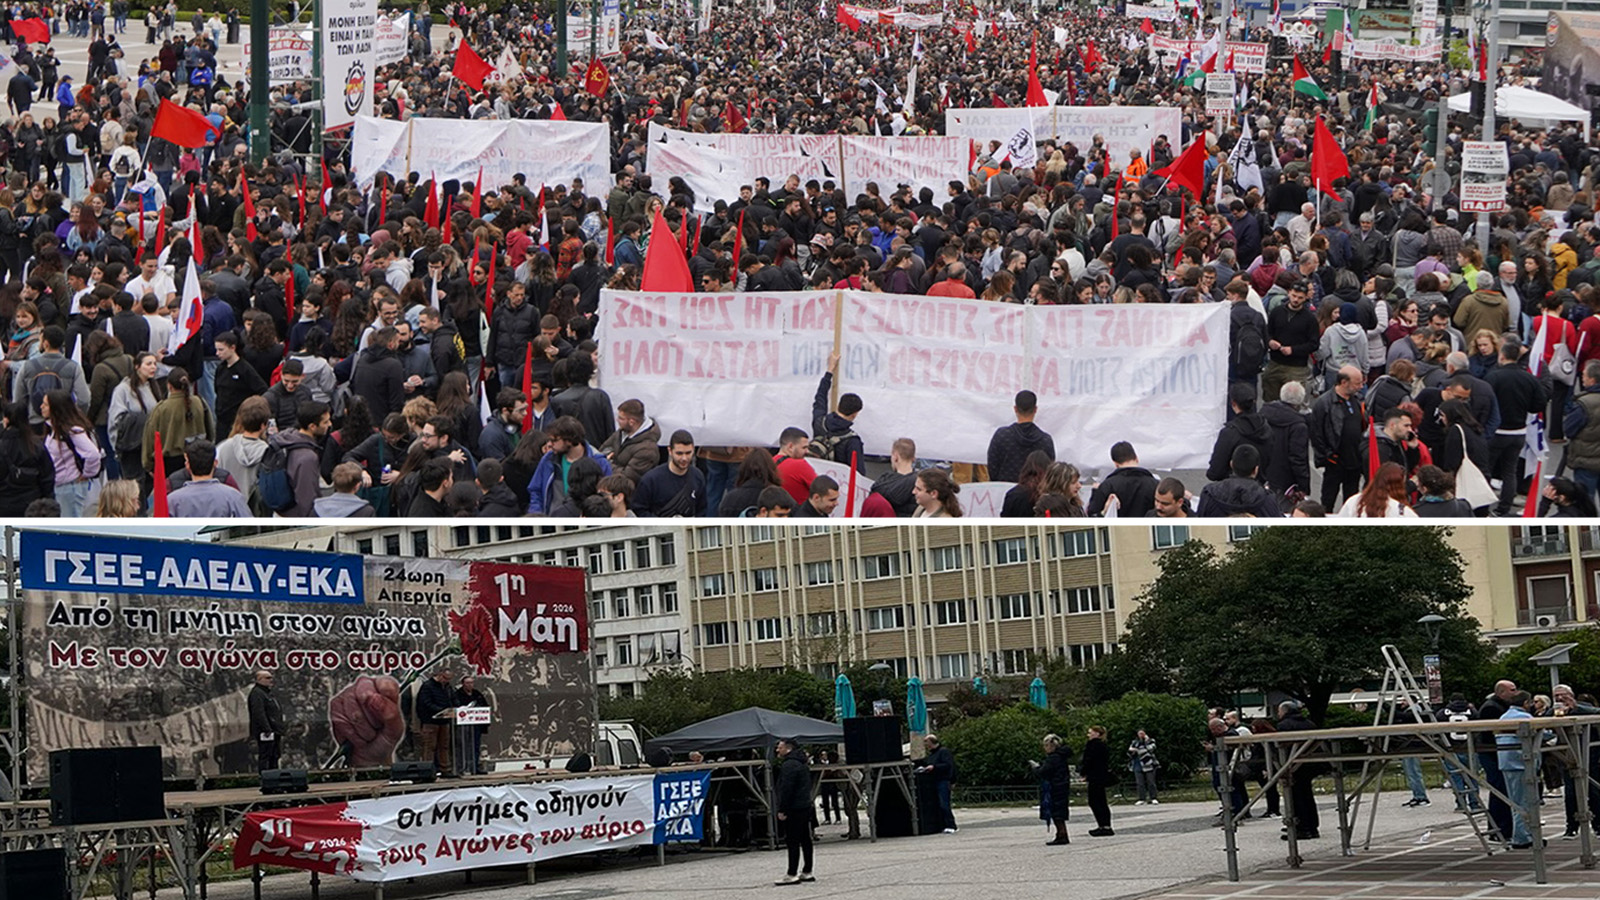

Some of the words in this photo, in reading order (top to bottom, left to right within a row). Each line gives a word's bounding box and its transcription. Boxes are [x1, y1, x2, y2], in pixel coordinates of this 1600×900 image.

[329, 17, 356, 29] ΜΟΝΗ
[330, 30, 353, 42] ΕΙΝΑΙ
[337, 44, 354, 55] ΤΩΝ
[1463, 201, 1503, 209] ΠΑΜΕ
[44, 549, 357, 598] ΓΣΕΕ-ΑΔΕΔΥ-ΕΚΑ
[384, 567, 445, 586] 24ωρη
[378, 588, 452, 605] Απεργία
[494, 572, 526, 606] 1η
[552, 604, 574, 613] 2026
[50, 600, 111, 628] Από
[123, 605, 158, 633] τη
[169, 604, 261, 638] μνήμη
[269, 613, 333, 635] στον
[343, 609, 424, 640] αγώνα
[498, 604, 578, 651] Μάη
[50, 641, 99, 669] Με
[109, 647, 167, 668] τον
[179, 641, 278, 673] αγώνα
[285, 648, 340, 671] στο
[349, 644, 427, 674] αύριο
[660, 780, 702, 800] ΓΣΕΕ
[397, 808, 422, 829] Οι
[431, 796, 528, 825] Μνήμες
[536, 785, 628, 816] οδηγούν
[259, 817, 293, 843] 1η
[665, 817, 693, 837] ΕΚΑ
[320, 837, 347, 850] 2026
[378, 842, 427, 867] τους
[435, 829, 536, 861] Αγώνες
[540, 828, 576, 846] του
[581, 816, 646, 842] αύριο
